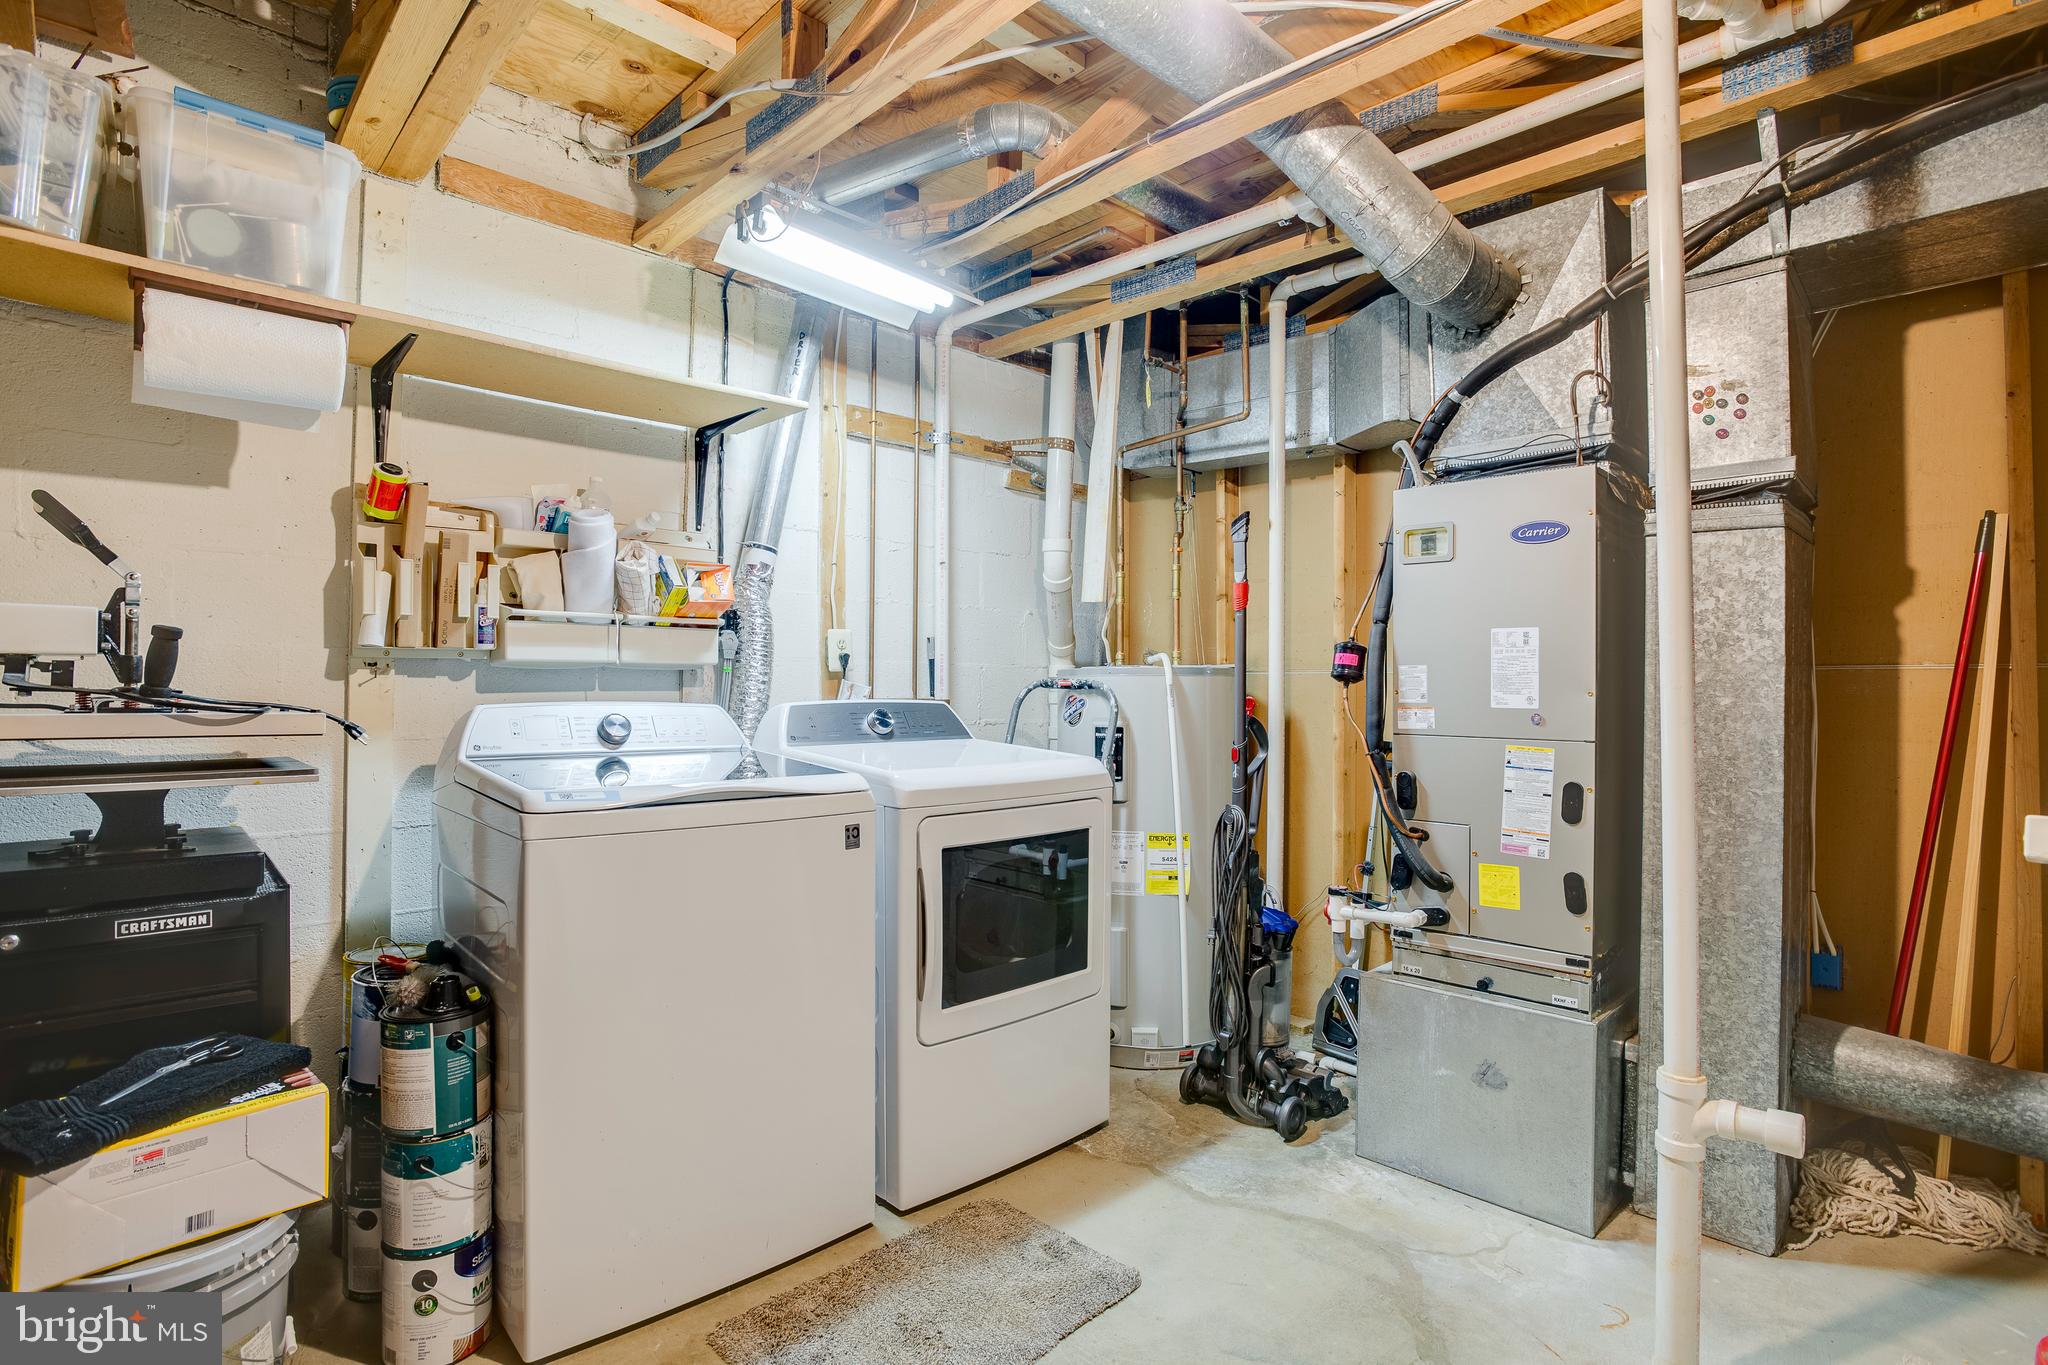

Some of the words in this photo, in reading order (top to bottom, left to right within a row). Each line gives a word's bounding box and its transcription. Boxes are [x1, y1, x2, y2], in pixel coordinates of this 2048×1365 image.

[792, 332, 806, 376] DRYER
[1518, 526, 1560, 537] Carrier
[120, 914, 207, 934] CRAFTSMAN
[420, 1300, 432, 1310] 10
